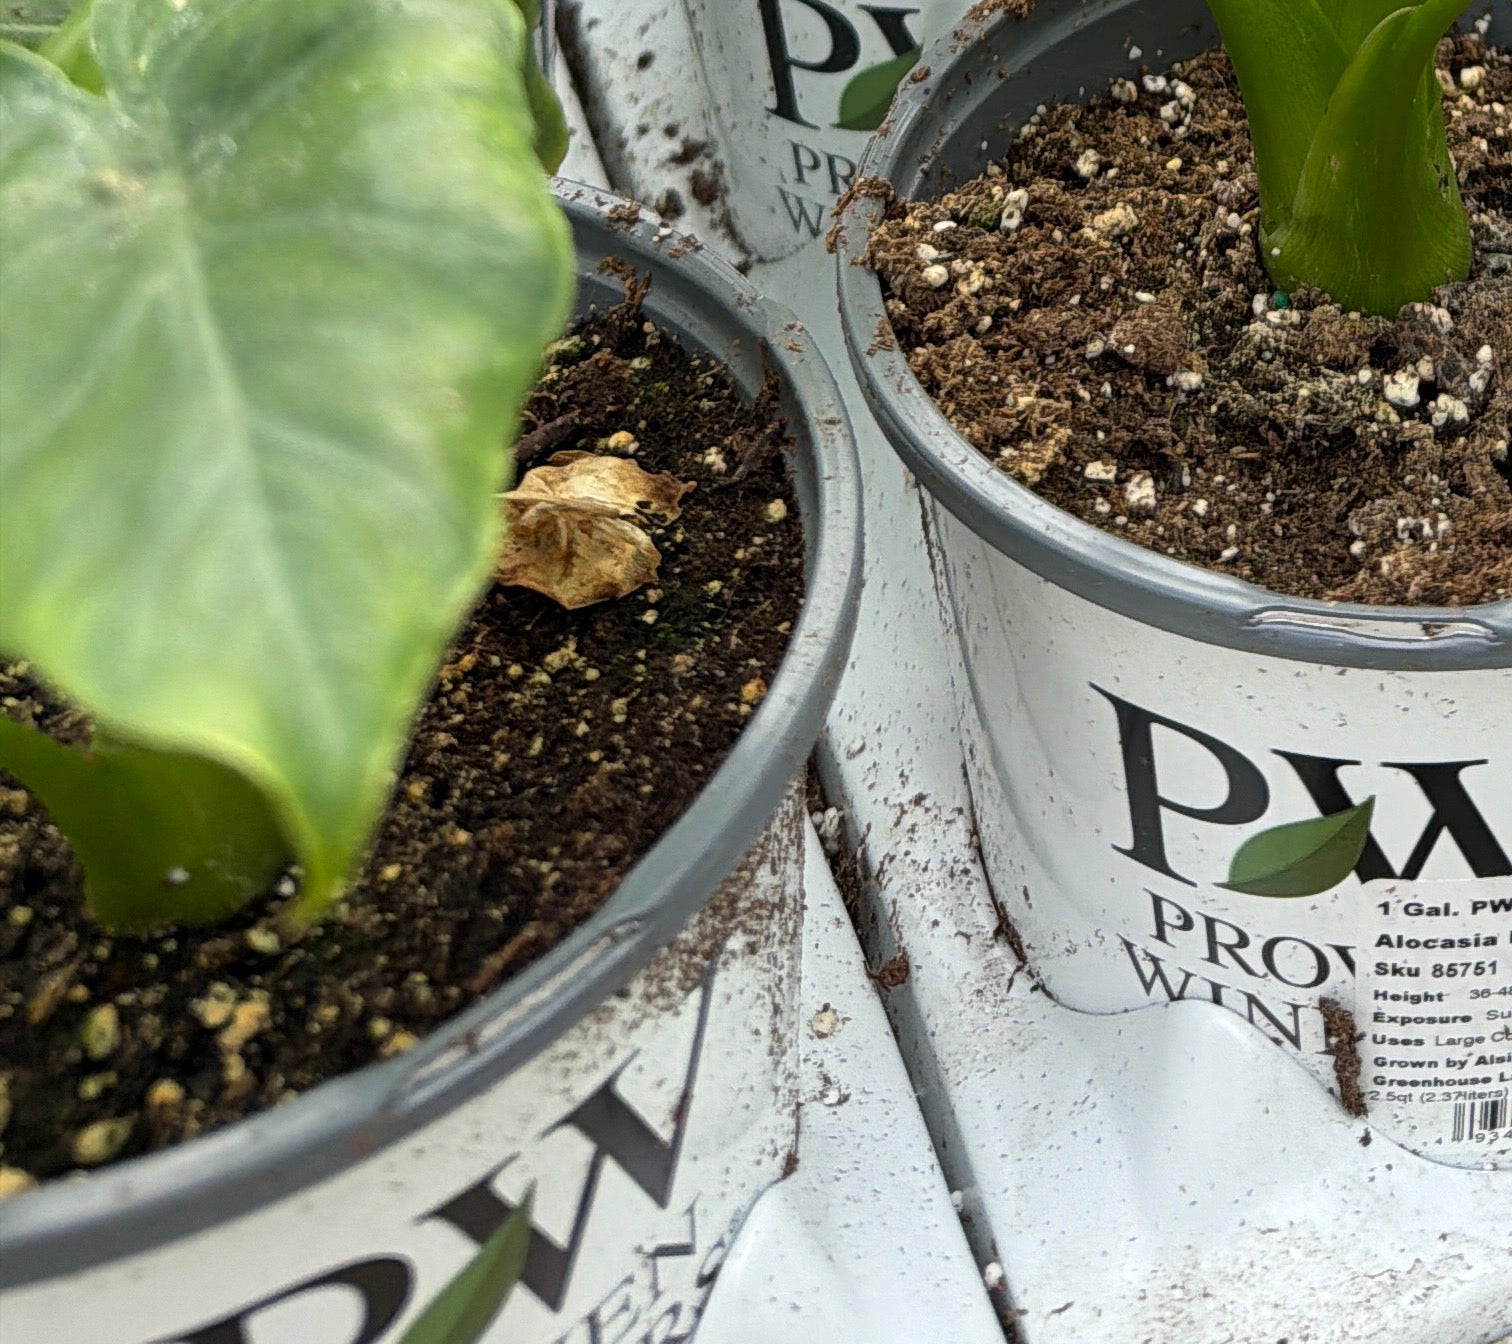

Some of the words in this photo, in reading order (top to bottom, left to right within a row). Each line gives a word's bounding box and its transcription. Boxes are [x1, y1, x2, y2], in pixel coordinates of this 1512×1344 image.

[1377, 901, 1391, 916] 1
[1403, 900, 1459, 917] Gal.
[1374, 933, 1498, 949] Alocasia
[1373, 962, 1421, 978] Sku
[1431, 960, 1498, 978] 85751
[1373, 989, 1445, 1005] Height
[1373, 1011, 1473, 1025] Exposure
[1372, 1033, 1425, 1047] Uses
[1435, 1033, 1486, 1049] Large
[1373, 1056, 1439, 1069] Grown
[1445, 1056, 1469, 1071] by
[1373, 1075, 1492, 1089] Greenhouse
